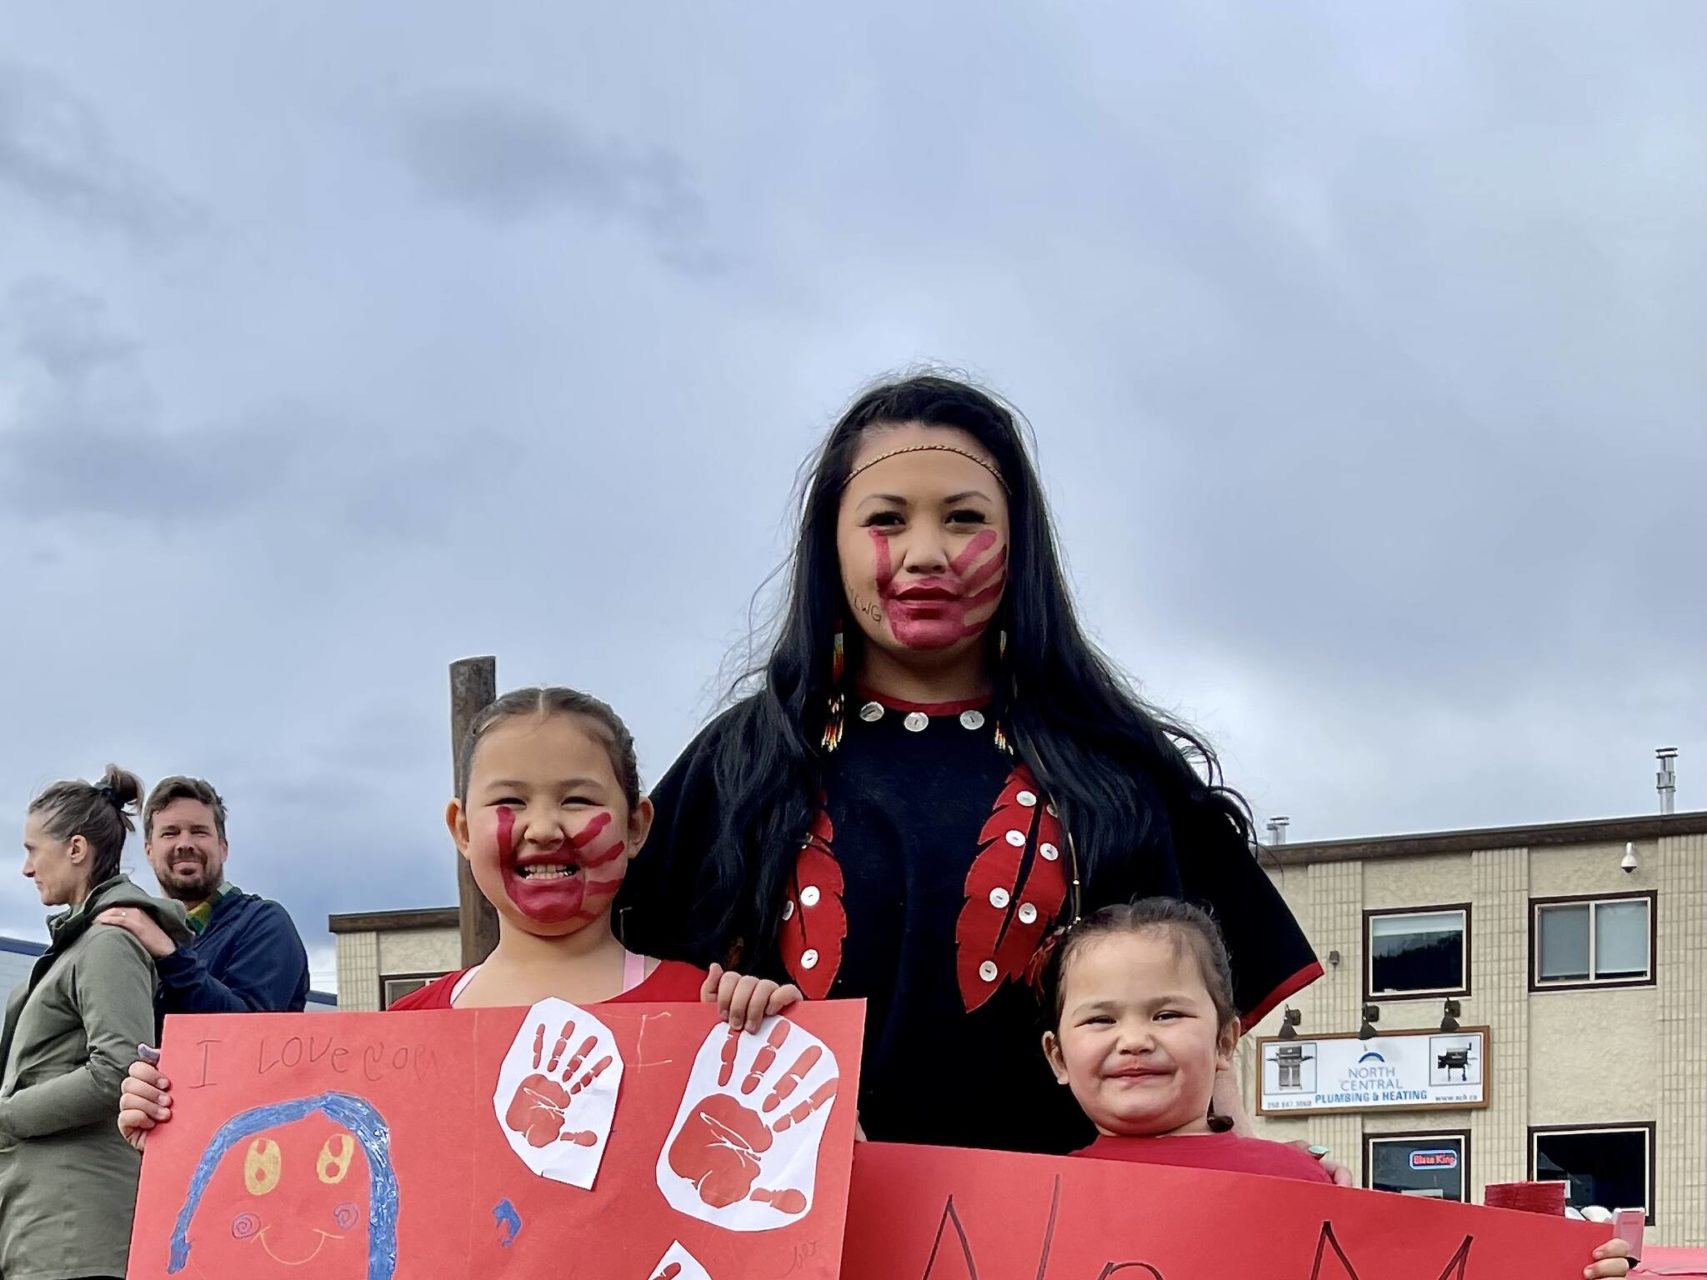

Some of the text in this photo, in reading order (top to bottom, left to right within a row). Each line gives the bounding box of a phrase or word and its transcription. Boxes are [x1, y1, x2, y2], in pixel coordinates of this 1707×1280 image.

[188, 1038, 222, 1090] I
[1348, 1066, 1396, 1080] NORTH
[1340, 1078, 1404, 1092] CENTRAL
[1314, 1089, 1428, 1104] PLUMBING & HEATING
